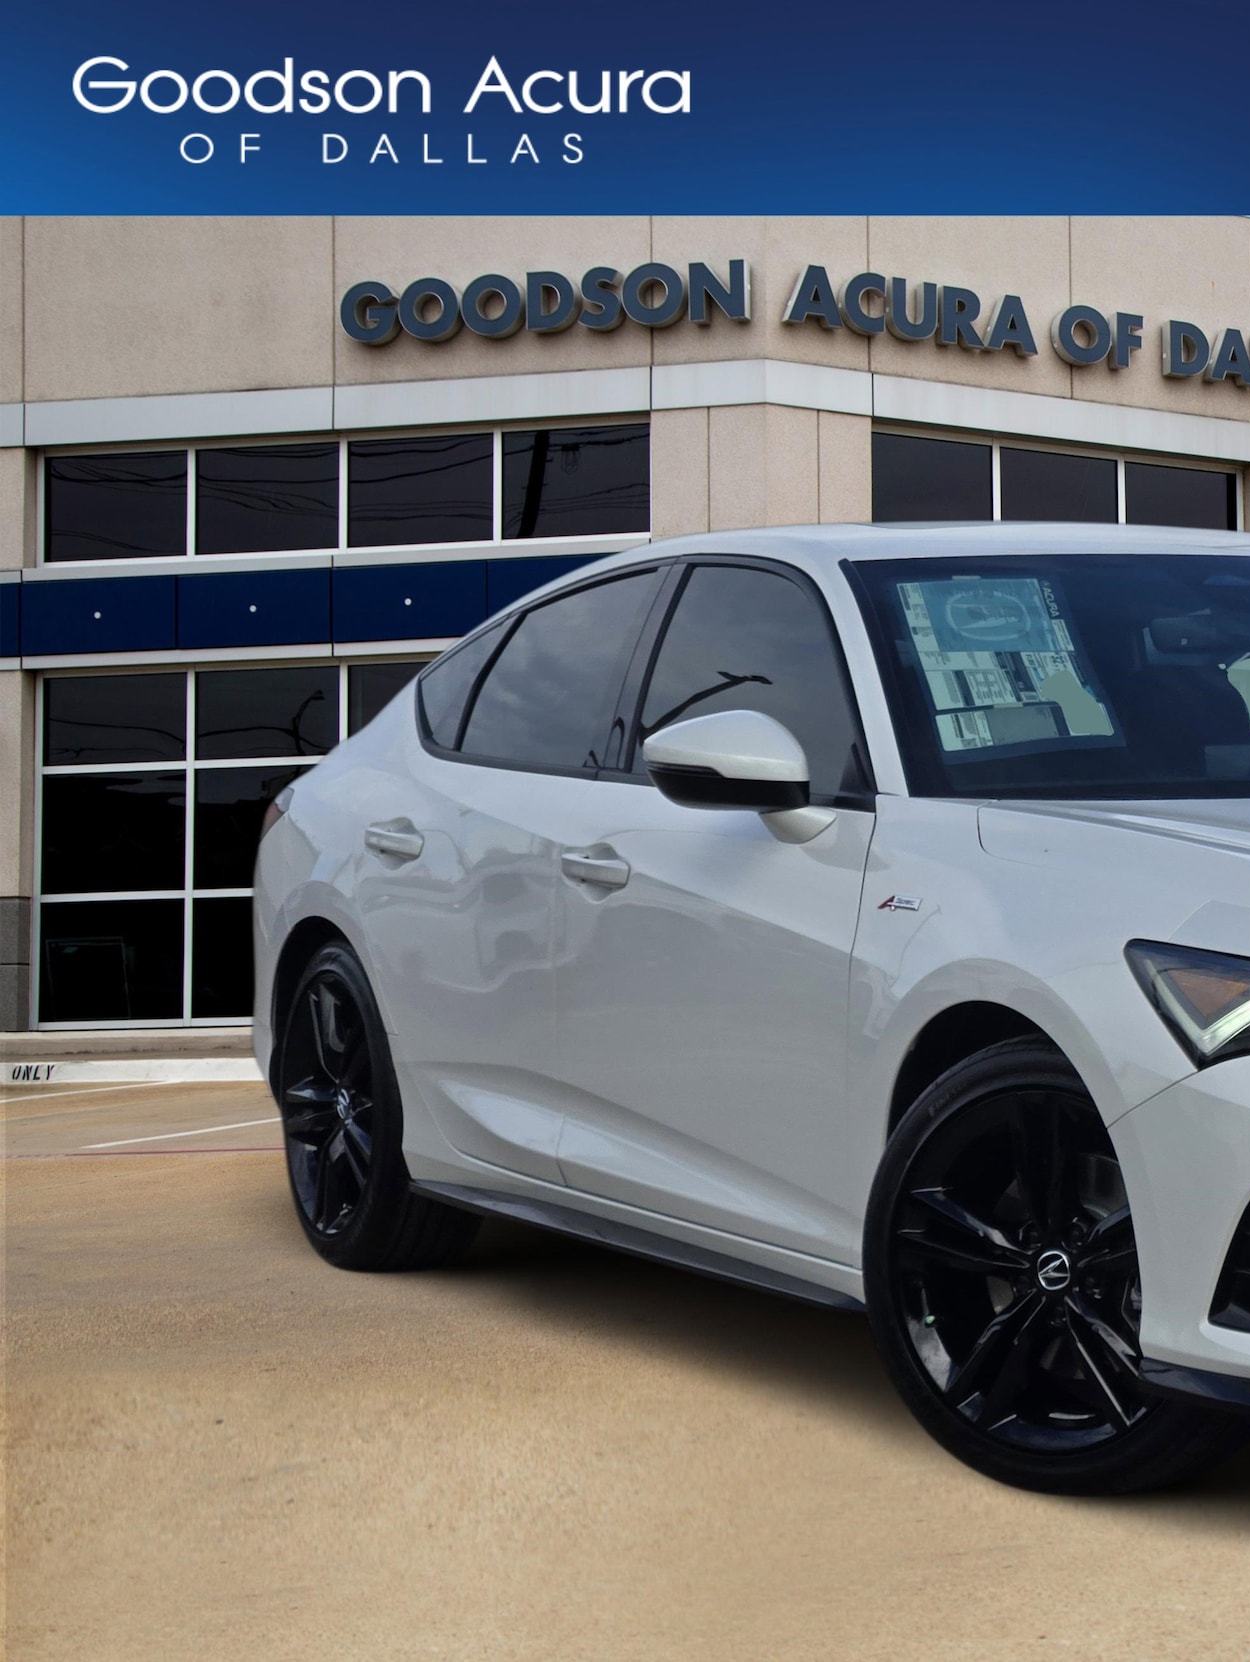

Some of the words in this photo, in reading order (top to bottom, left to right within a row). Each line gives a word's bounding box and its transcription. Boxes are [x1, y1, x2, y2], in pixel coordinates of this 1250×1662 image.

[340, 258, 752, 347] GOODSON
[782, 264, 1039, 358] ACURA
[1050, 305, 1144, 370] OF
[1042, 586, 1060, 618] ACURA
[12, 1064, 56, 1081] ONLY
